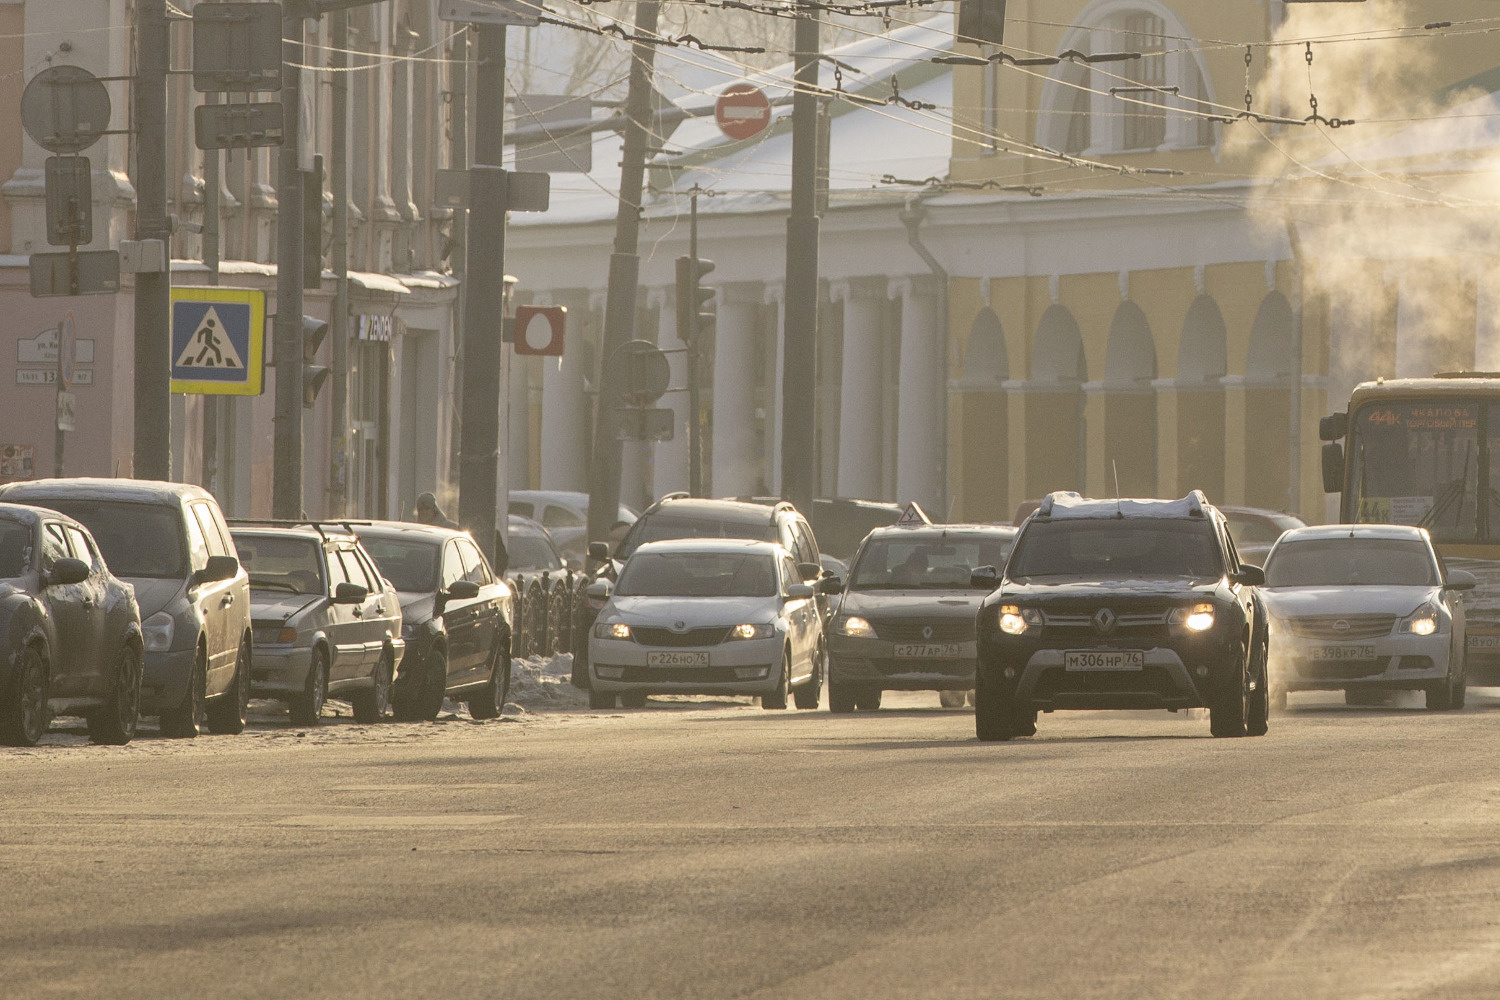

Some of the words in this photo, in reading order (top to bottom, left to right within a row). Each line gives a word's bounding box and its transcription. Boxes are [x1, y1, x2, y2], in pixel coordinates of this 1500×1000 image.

[43, 371, 60, 382] 13
[651, 653, 693, 664] Р226НО
[1069, 654, 1122, 667] М306НР
